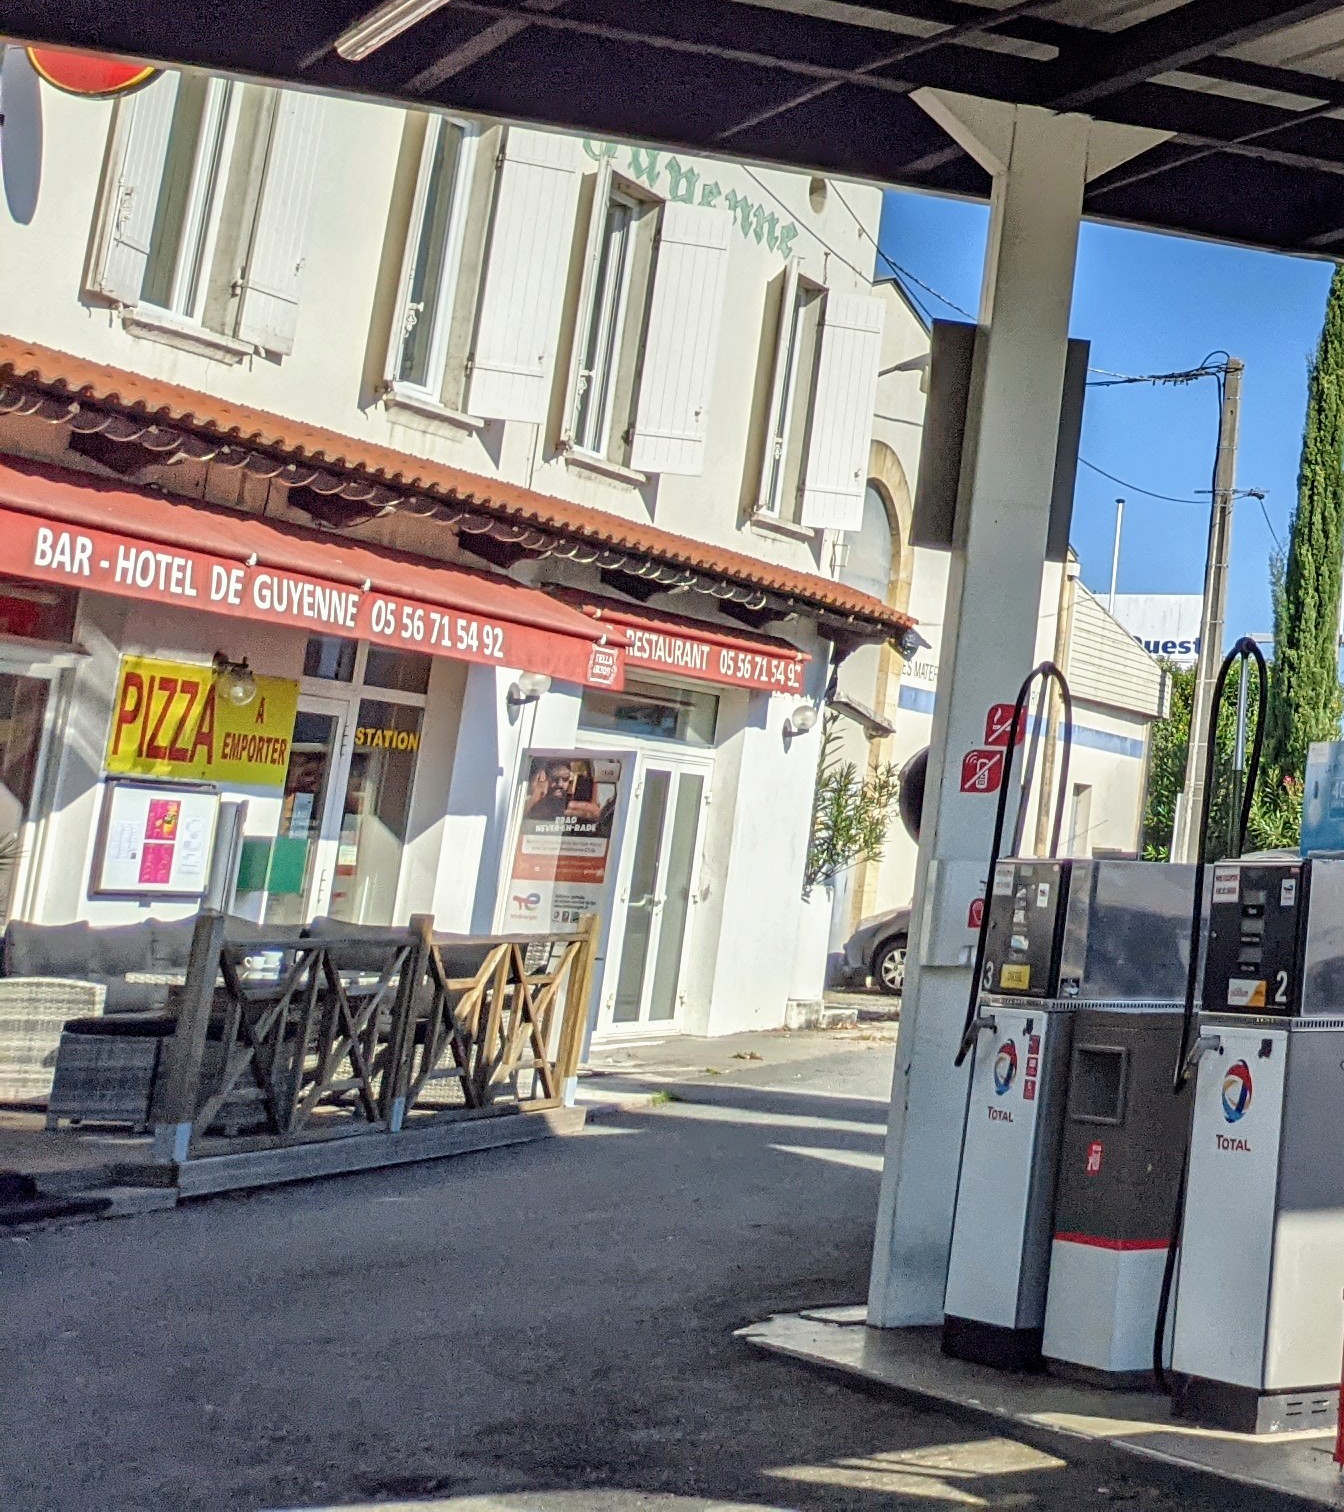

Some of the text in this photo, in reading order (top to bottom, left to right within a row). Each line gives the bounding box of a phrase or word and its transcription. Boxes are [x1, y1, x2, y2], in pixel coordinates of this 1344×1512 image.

[34, 526, 94, 577] BAR
[114, 544, 198, 597] HOTEL
[210, 564, 245, 605] DE
[253, 573, 360, 628] GUYENNE
[371, 599, 396, 635] 05
[401, 606, 424, 641] 56
[430, 612, 452, 648] 71
[456, 618, 479, 653] 54
[483, 626, 505, 658] 92
[625, 629, 710, 670] RESTAURANT
[719, 648, 735, 675] 05
[736, 653, 751, 679] 56
[754, 656, 768, 681] 71
[771, 660, 786, 685] 54
[1132, 635, 1201, 655] uest
[111, 671, 218, 766] PIZZA
[254, 697, 266, 725] A
[220, 731, 288, 766] EMPORTER
[354, 727, 420, 751] STATION
[983, 960, 994, 989] 3
[1274, 970, 1288, 1004] 2
[987, 1106, 1014, 1123] TOTAL
[1215, 1133, 1251, 1152] TOTAL
